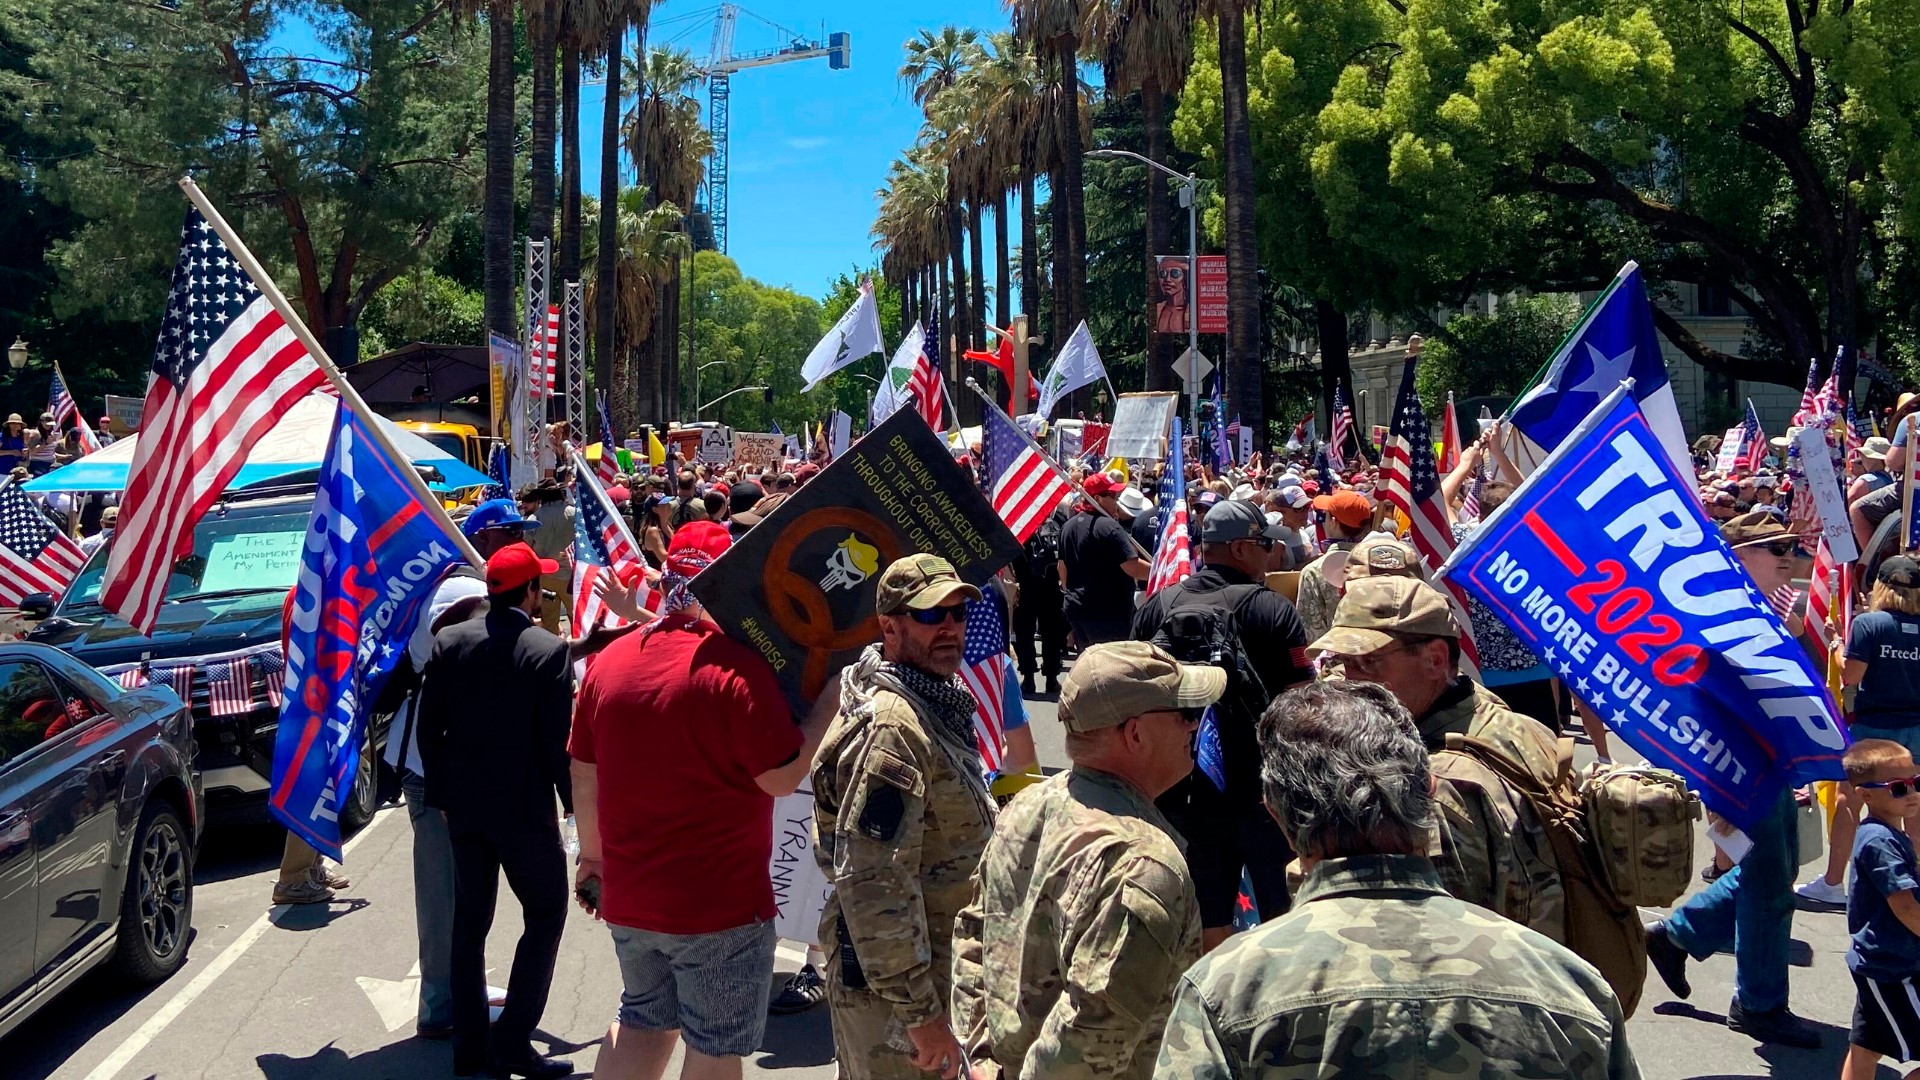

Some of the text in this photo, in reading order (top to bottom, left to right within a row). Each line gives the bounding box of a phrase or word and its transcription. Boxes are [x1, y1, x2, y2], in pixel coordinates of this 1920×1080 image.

[739, 434, 775, 445] Welcome
[741, 446, 775, 456] GRAND
[850, 452, 934, 553] THROUGHOUT OUR
[879, 454, 972, 567] TO THE CORRUPTION
[889, 434, 992, 560] BRINGING AWARENESS
[223, 550, 297, 561] AMENDMENT
[234, 560, 254, 571] My
[239, 535, 276, 546] THE
[1576, 430, 1846, 751] TRUMP
[741, 616, 786, 673] #WHOISQ
[1567, 559, 1710, 687] 2020
[1487, 550, 1748, 784] NO MORE BULLSHIT
[1880, 644, 1920, 661] Freed
